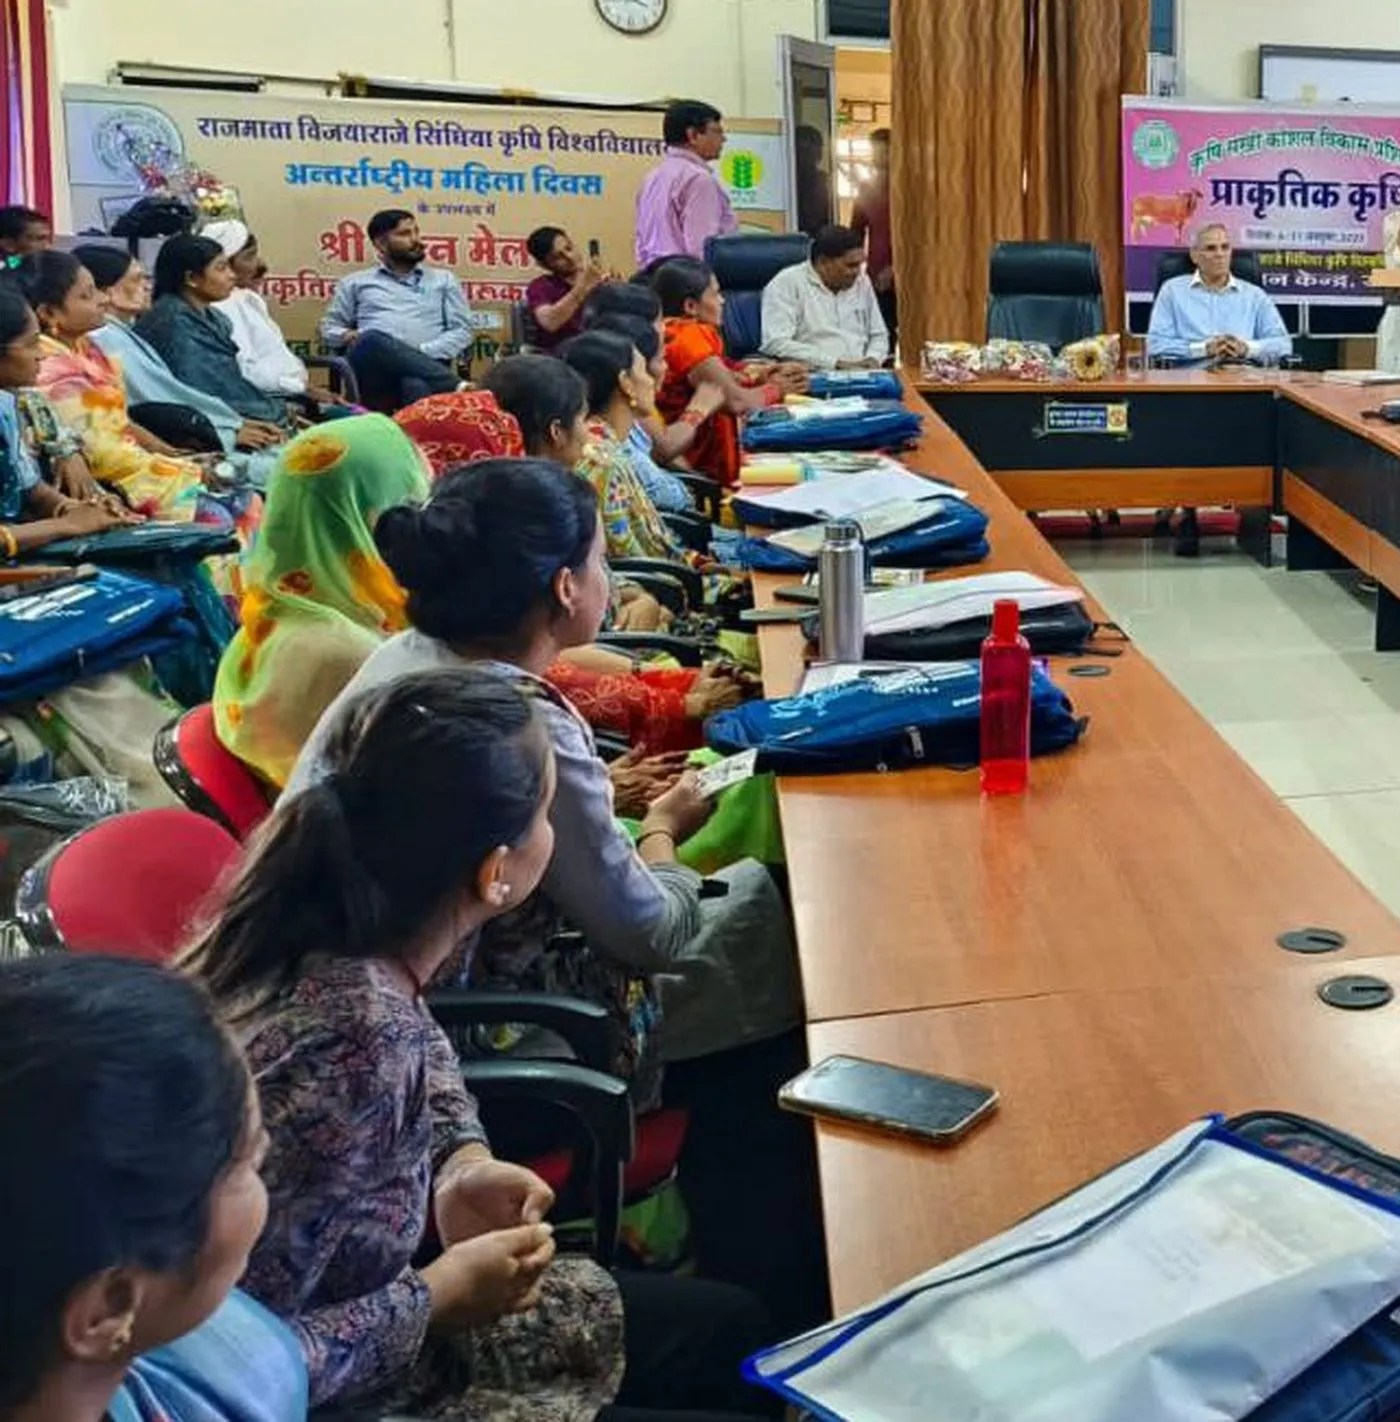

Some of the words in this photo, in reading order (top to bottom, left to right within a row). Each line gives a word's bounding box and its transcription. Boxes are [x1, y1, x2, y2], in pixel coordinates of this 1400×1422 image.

[197, 117, 292, 140] राजमाता
[296, 114, 409, 146] विजयाराजे
[415, 118, 493, 149] सिंधिया
[548, 125, 668, 157] विश्वविद्याल
[440, 161, 527, 196] महिला
[532, 165, 603, 197] दिवस
[1211, 169, 1342, 219] प्राकृतिक
[320, 219, 365, 263] श्री
[467, 222, 530, 266] मेल
